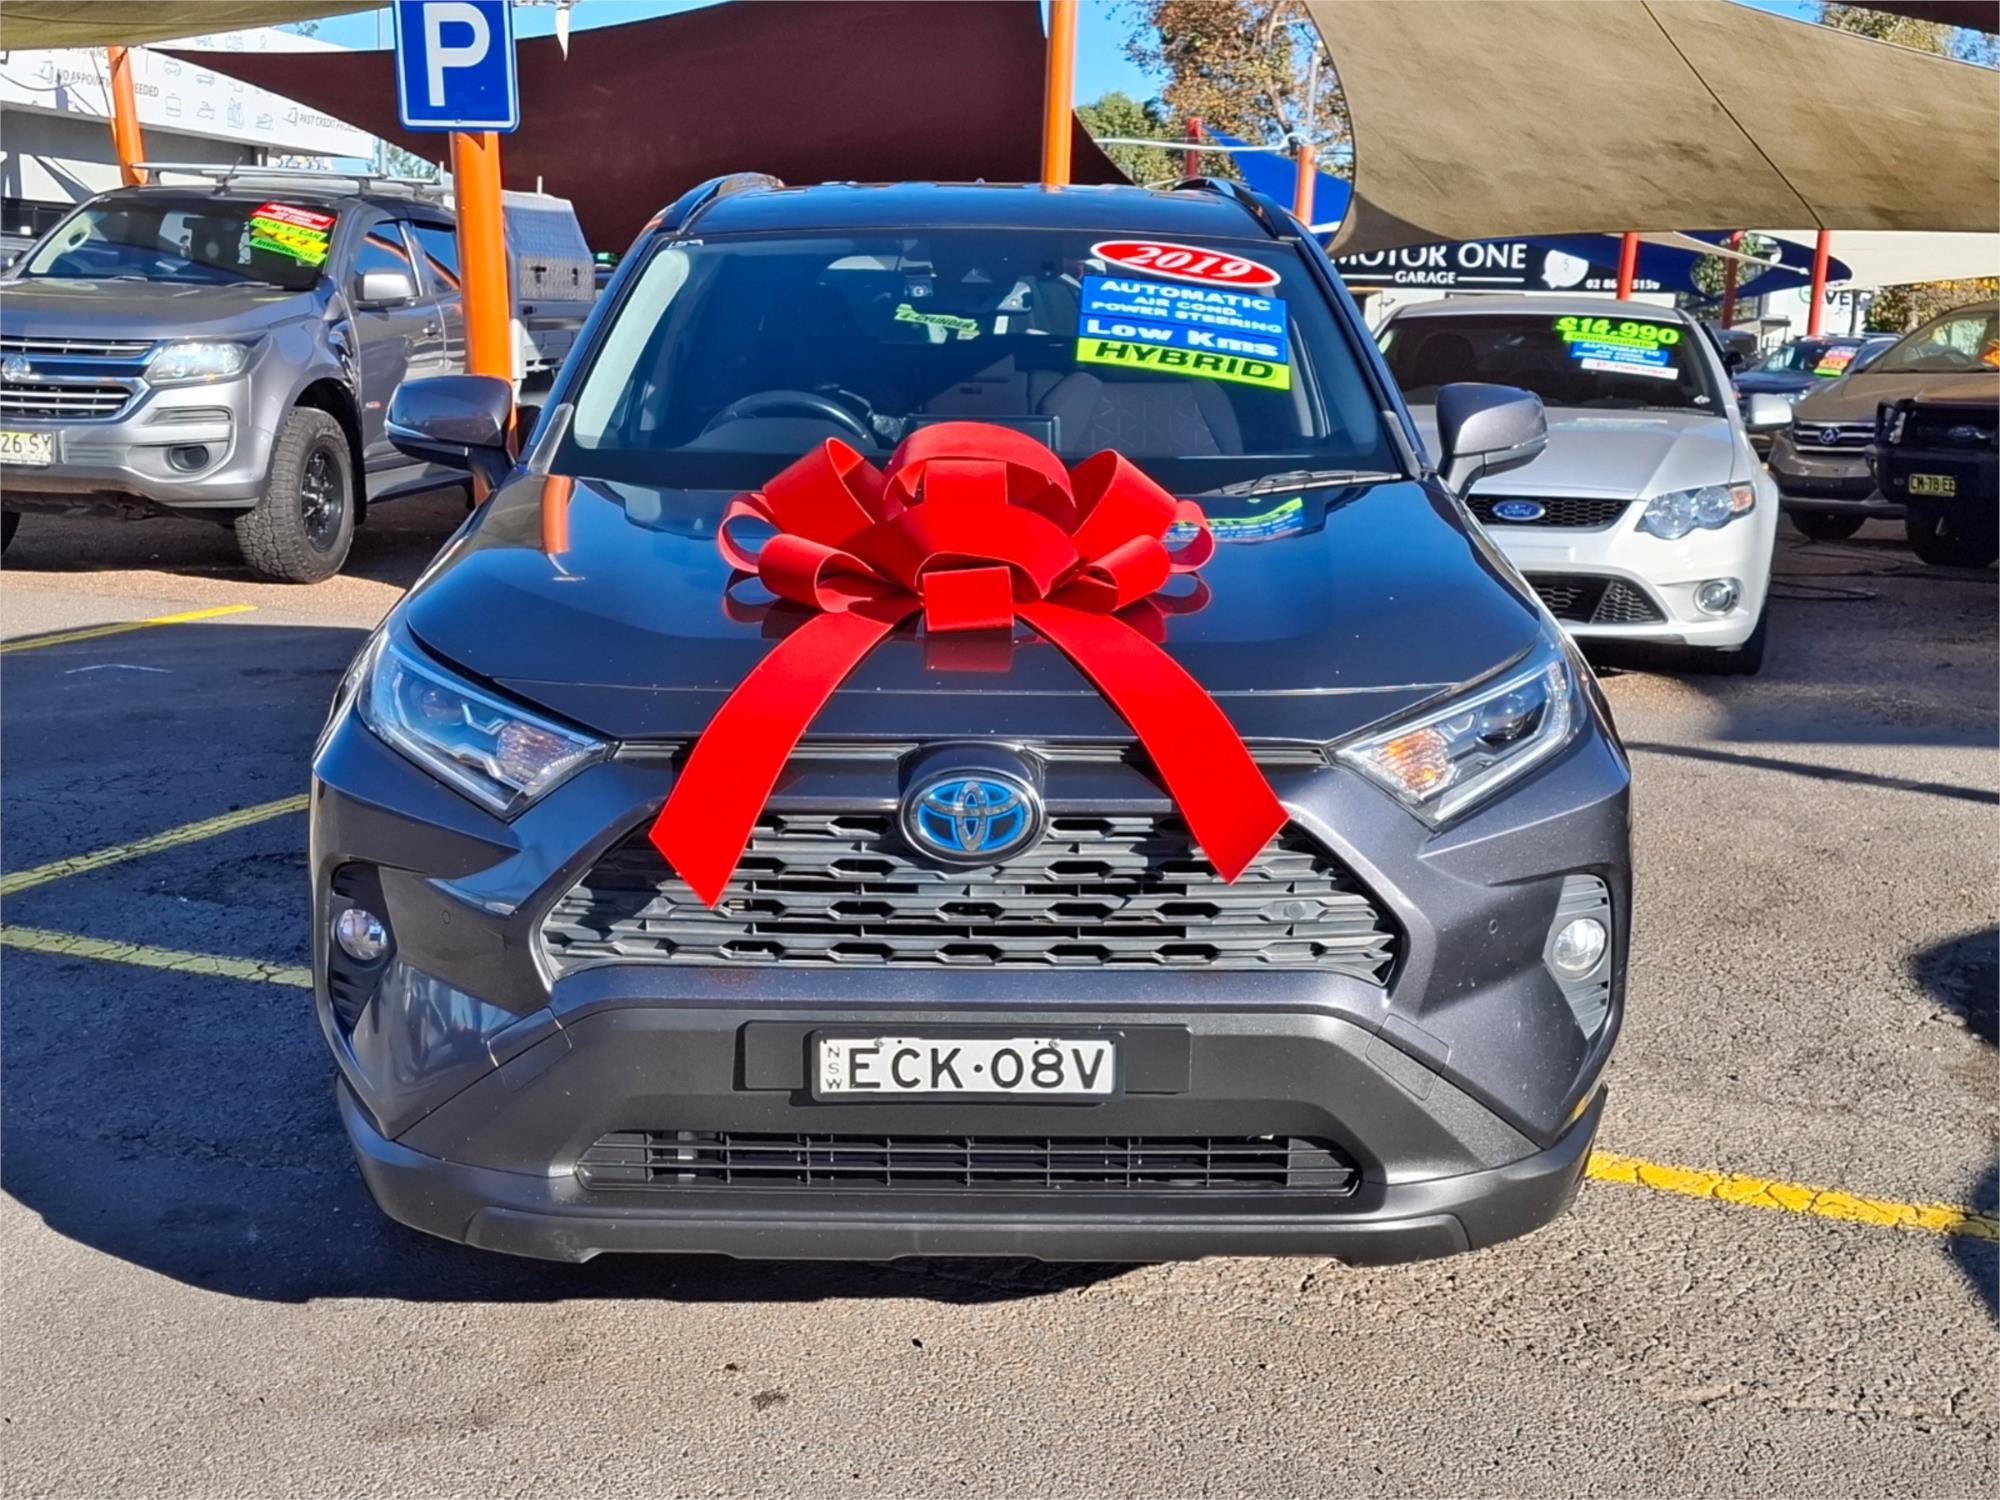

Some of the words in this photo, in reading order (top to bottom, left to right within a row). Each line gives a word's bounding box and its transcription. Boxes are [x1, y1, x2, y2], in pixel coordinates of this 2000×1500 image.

[423, 2, 491, 107] P
[134, 83, 159, 97] EEDED
[1120, 246, 1253, 277] 2019
[1458, 243, 1527, 268] ONE
[1395, 271, 1456, 285] GARAGE
[1100, 281, 1271, 311] AUTOMATIC
[1134, 296, 1170, 307] AIR
[1176, 300, 1242, 317] COND.
[1092, 301, 1168, 317] POWER
[1175, 310, 1283, 333] STEERING
[1556, 317, 1679, 344] $14.990
[1188, 330, 1279, 358] Kms
[1095, 342, 1274, 379] HYBRID
